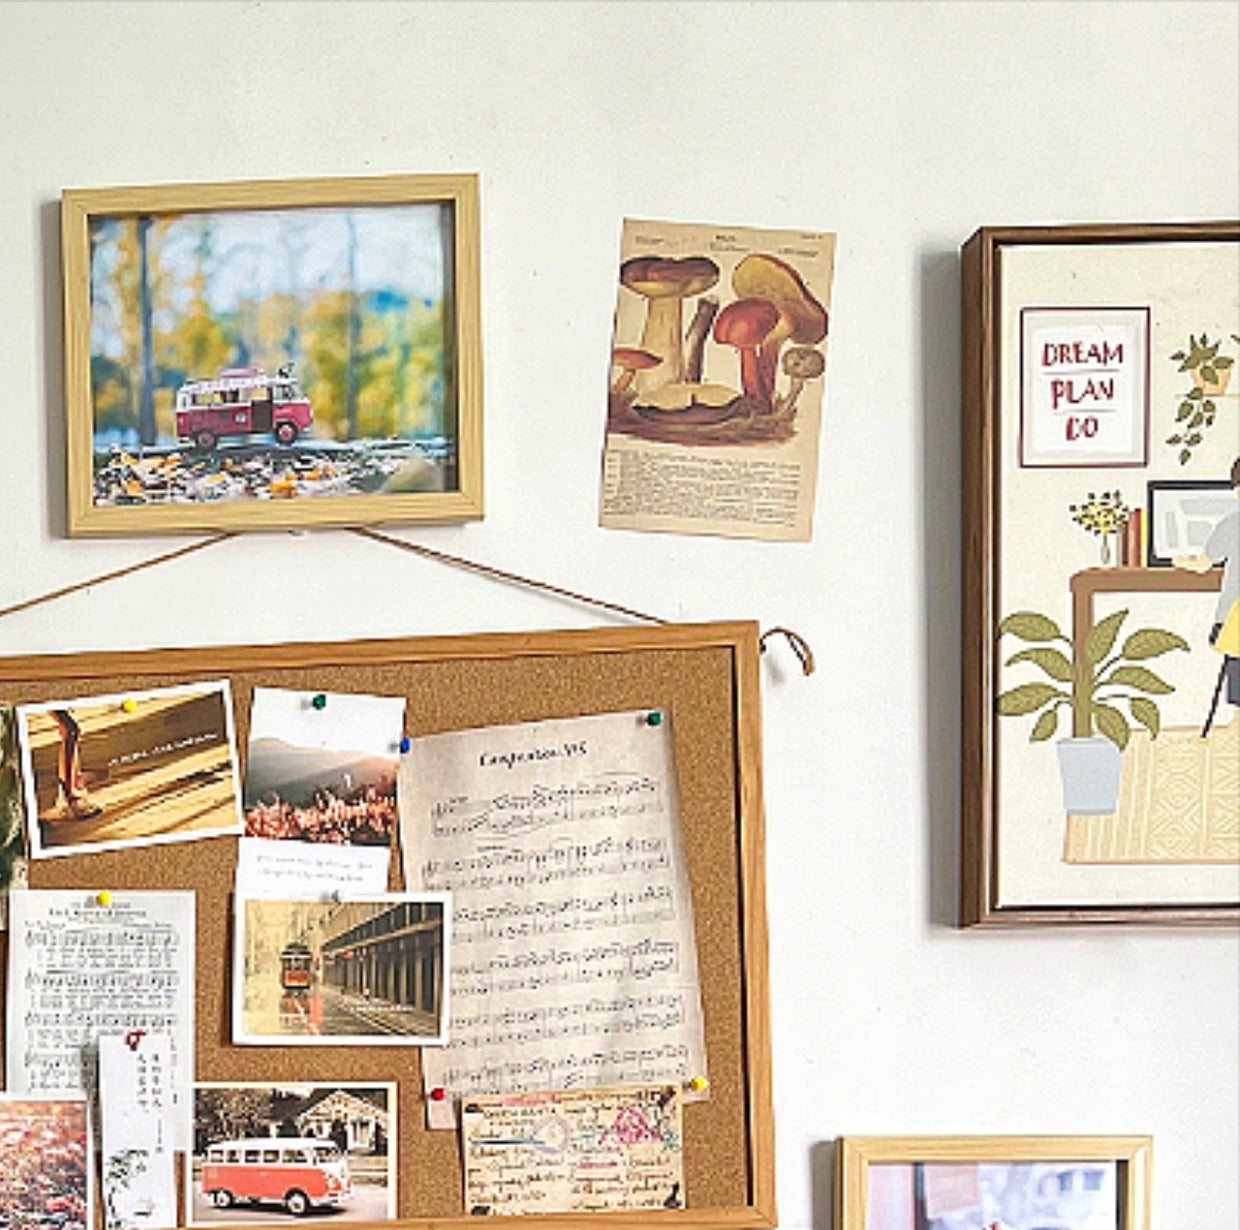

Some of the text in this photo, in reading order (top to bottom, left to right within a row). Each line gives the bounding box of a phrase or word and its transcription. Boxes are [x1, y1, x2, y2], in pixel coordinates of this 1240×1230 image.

[1041, 341, 1123, 367] DREAM
[1051, 378, 1114, 410] PLAN
[1066, 416, 1098, 441] DO
